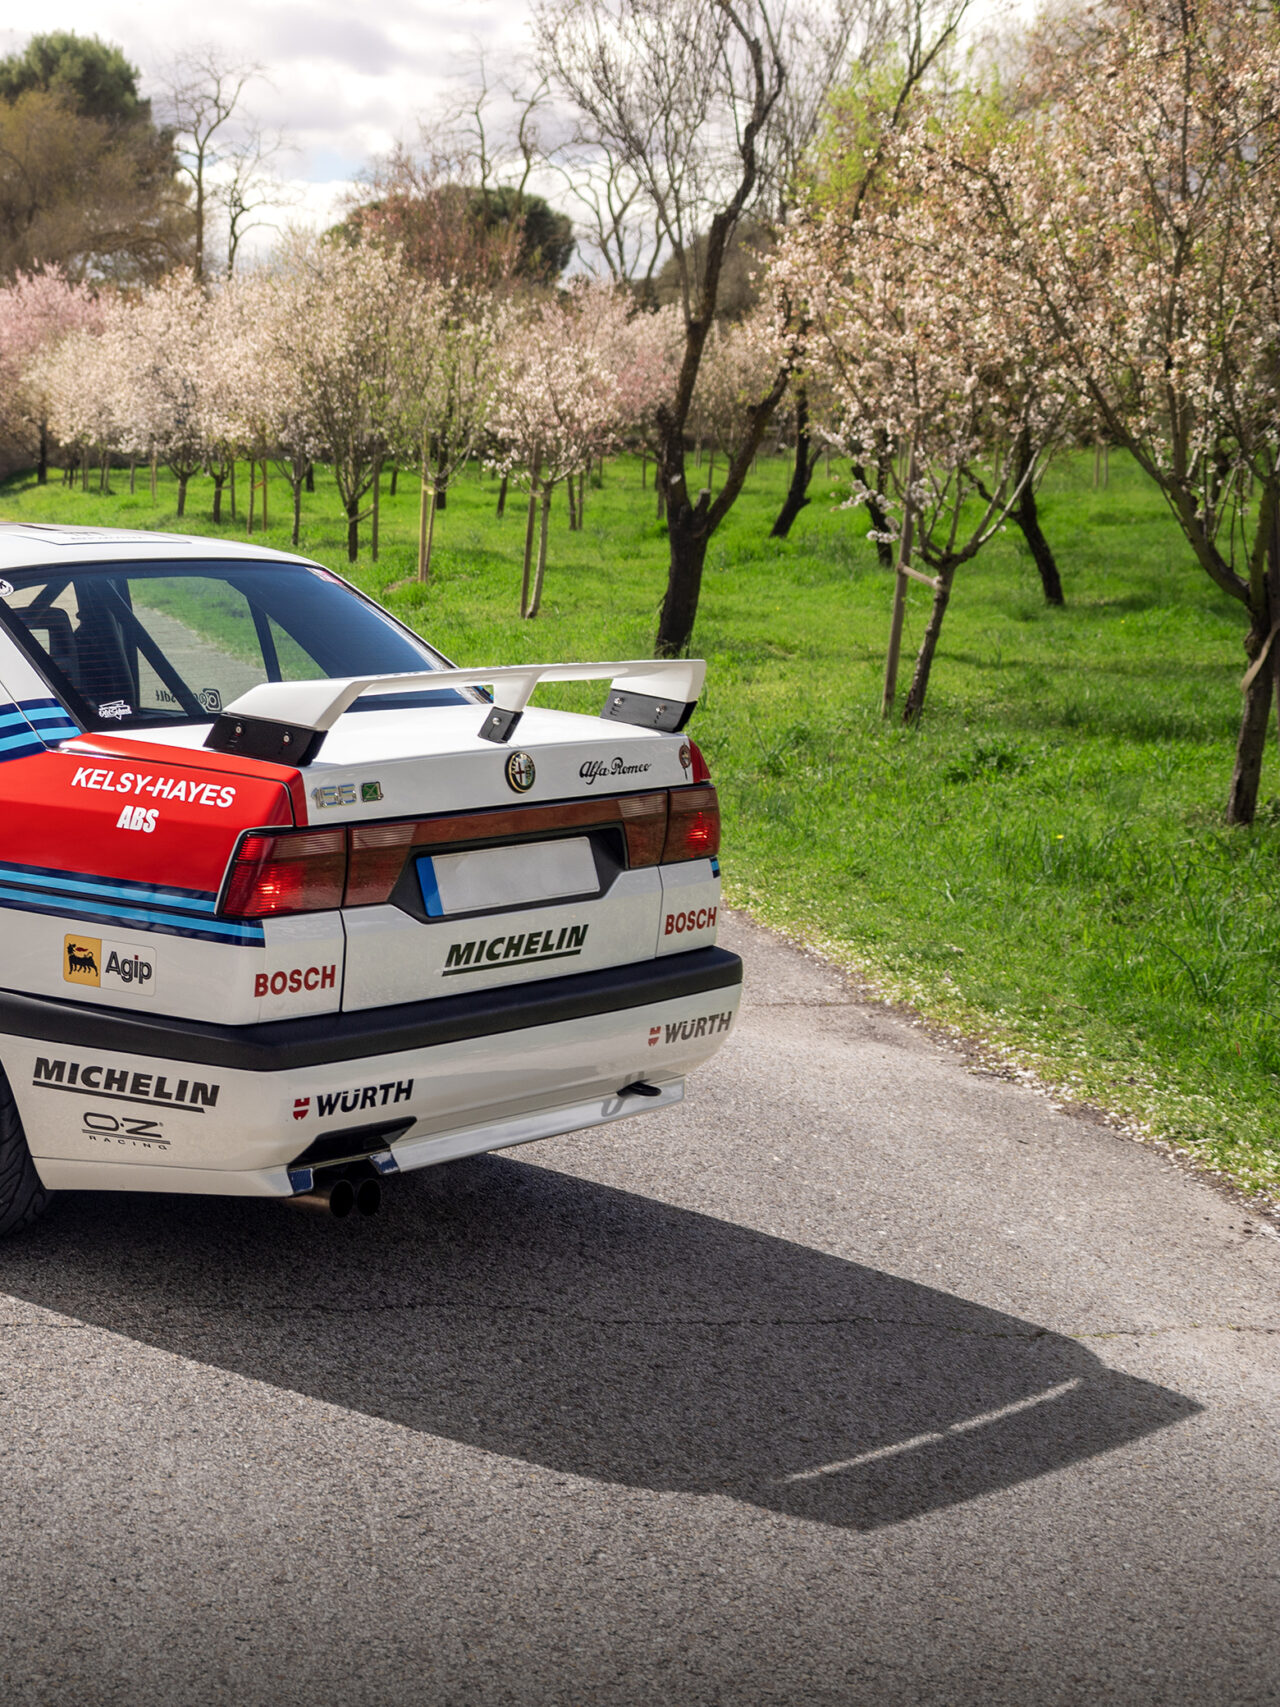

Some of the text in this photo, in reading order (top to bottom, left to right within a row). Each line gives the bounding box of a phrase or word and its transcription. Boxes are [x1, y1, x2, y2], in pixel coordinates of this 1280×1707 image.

[71, 767, 236, 808] KELSY-HAYES
[579, 757, 652, 785] Alfa Romeo
[311, 784, 357, 809] 155
[116, 805, 159, 833] ABS
[664, 907, 717, 935] BOSCH
[444, 924, 589, 968] MICHELIN
[105, 951, 152, 985] Agip
[254, 965, 336, 998] BOSCH
[664, 1011, 732, 1044] WÜRTH
[33, 1057, 220, 1107] MICHELIN
[316, 1079, 414, 1118] WÜRTH
[88, 1135, 168, 1151] RACING
